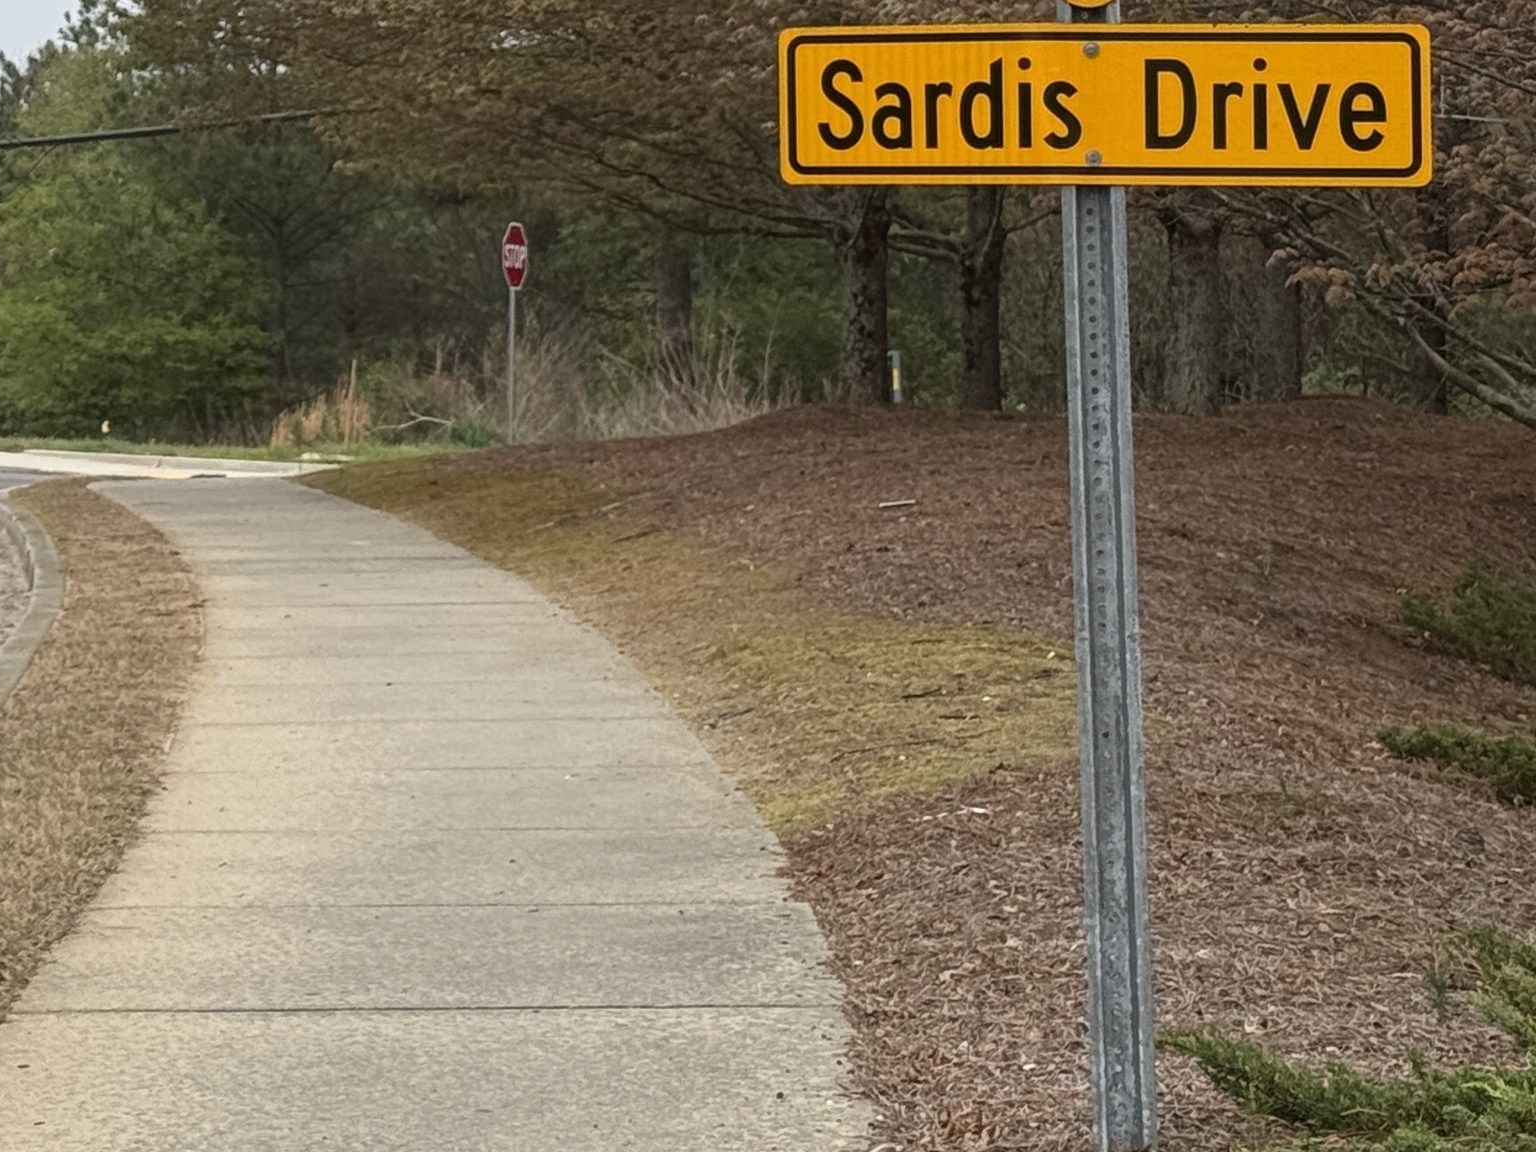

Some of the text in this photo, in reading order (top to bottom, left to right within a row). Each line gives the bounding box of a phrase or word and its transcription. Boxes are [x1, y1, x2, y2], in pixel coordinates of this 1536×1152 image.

[817, 56, 1388, 152] Sardis Drive
[505, 244, 527, 269] STOP
